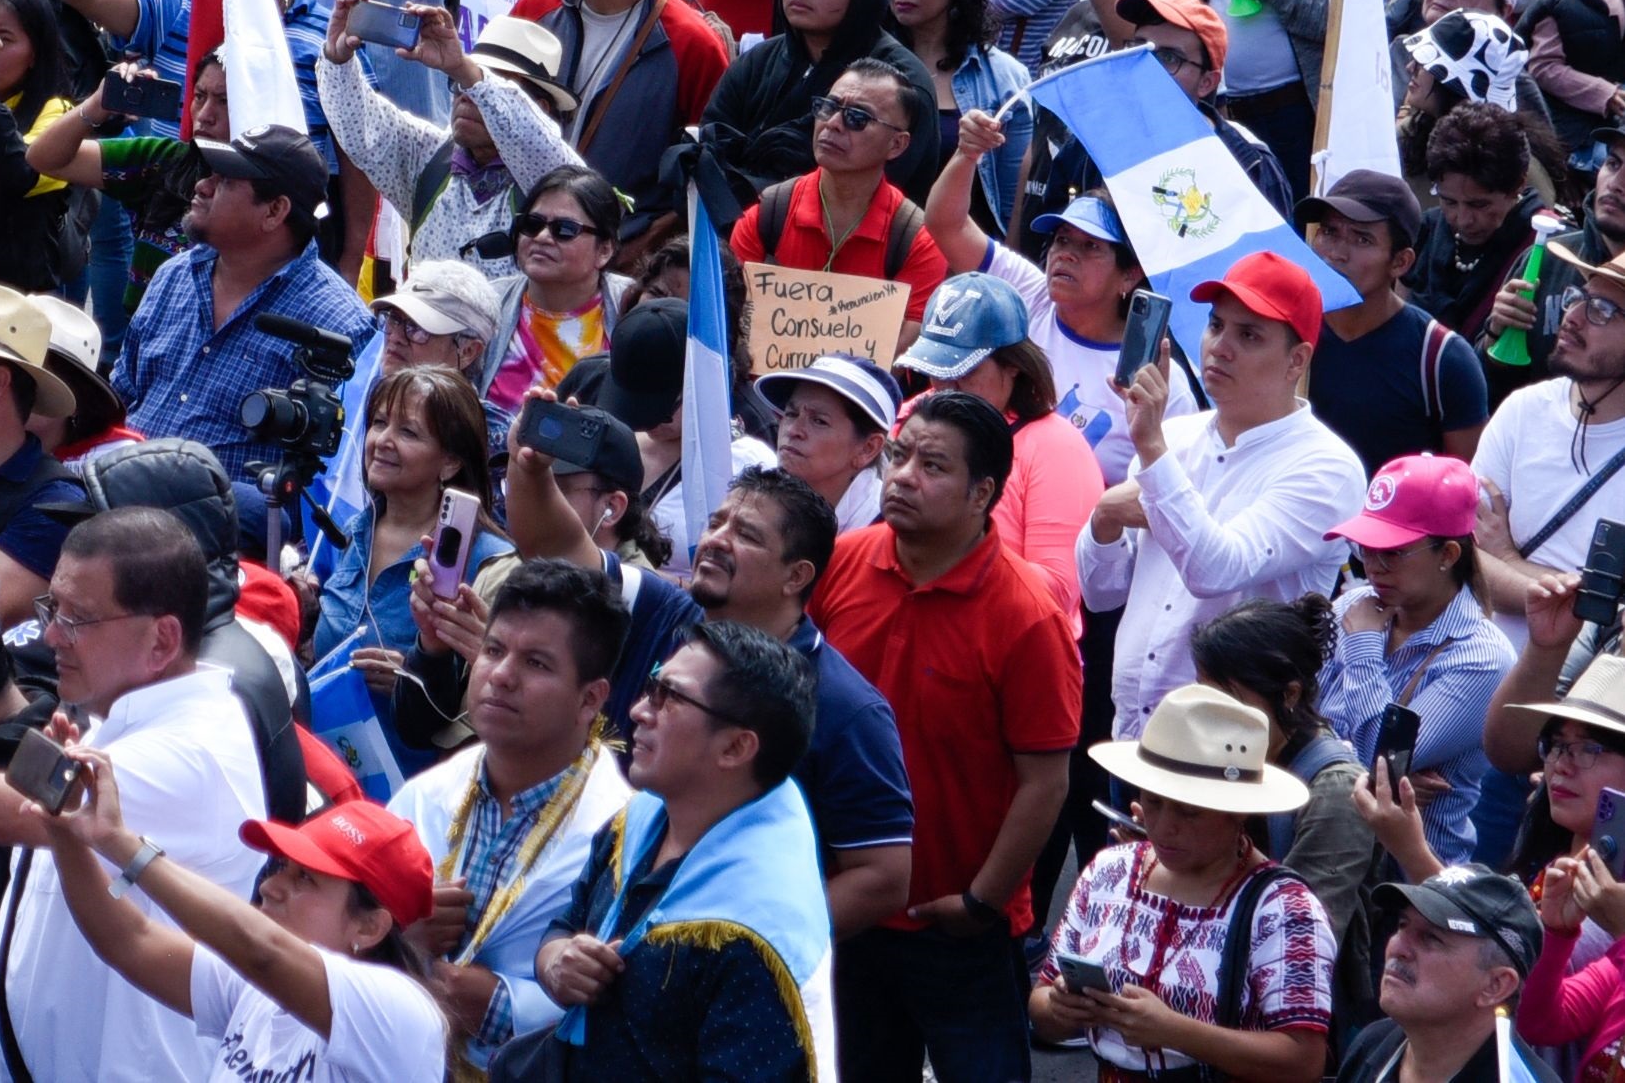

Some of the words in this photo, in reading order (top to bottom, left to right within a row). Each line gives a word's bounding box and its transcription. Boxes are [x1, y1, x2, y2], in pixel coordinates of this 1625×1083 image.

[754, 272, 834, 302] Fuera
[771, 307, 862, 339] Consuelo
[331, 815, 366, 846] BOSS
